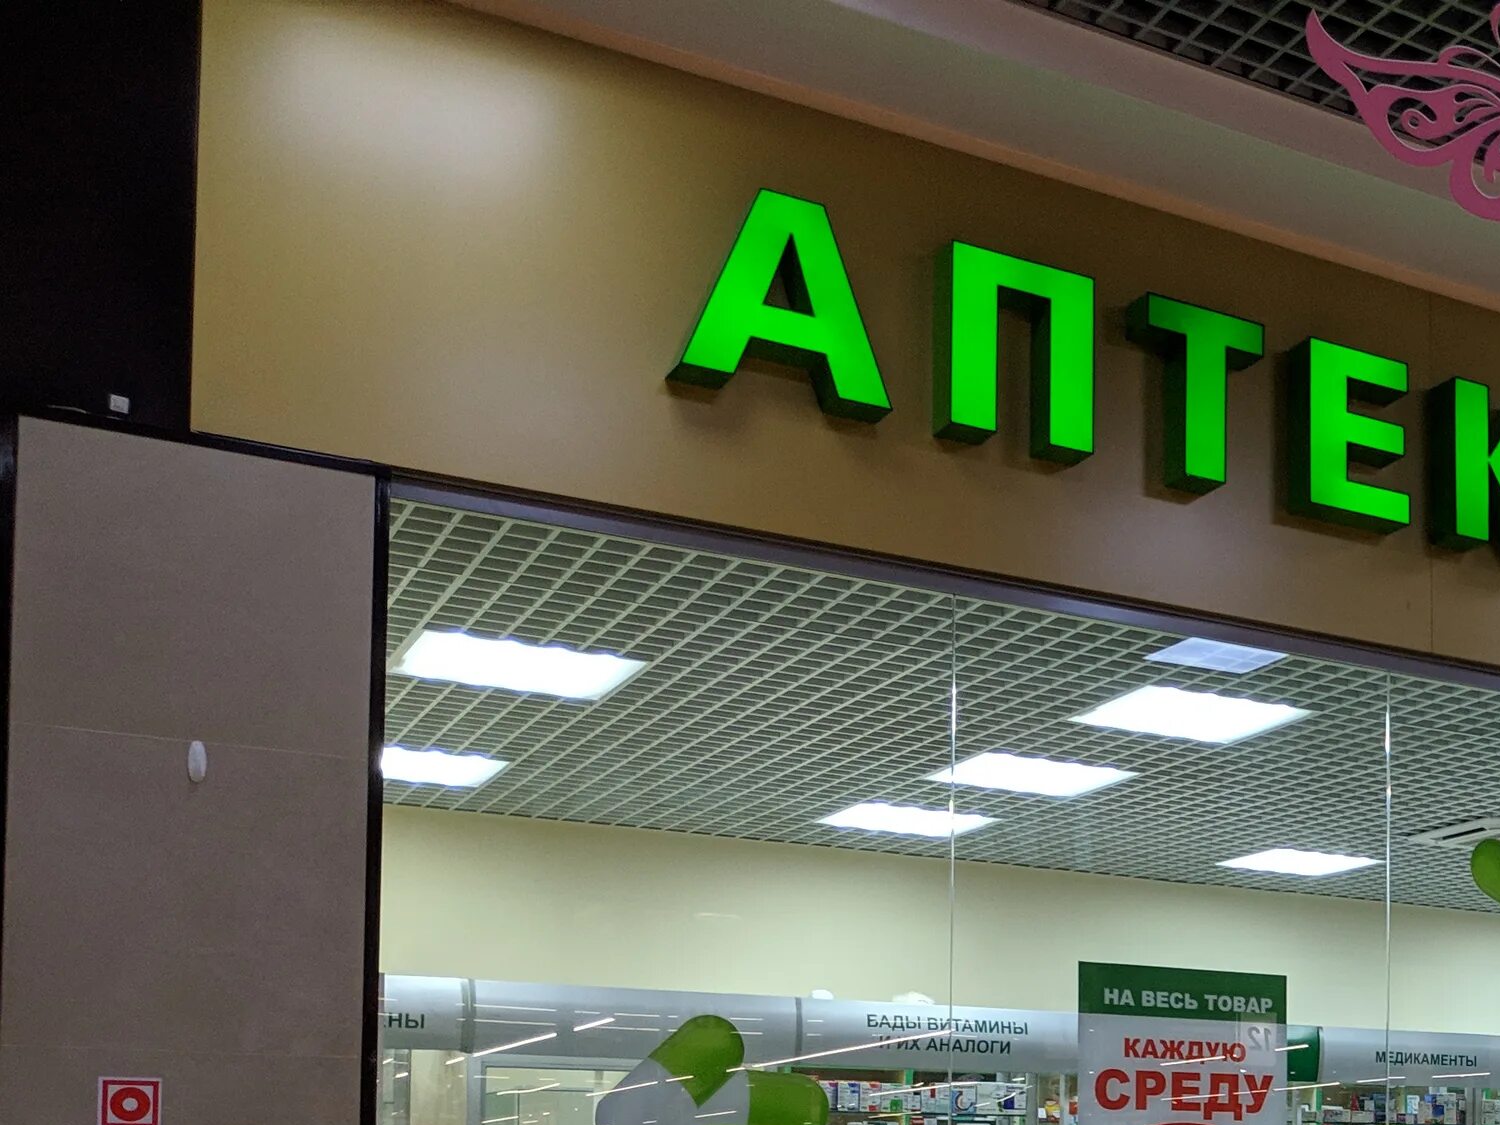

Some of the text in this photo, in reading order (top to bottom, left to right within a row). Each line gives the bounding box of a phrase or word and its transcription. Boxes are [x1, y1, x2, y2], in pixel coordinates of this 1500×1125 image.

[1103, 987, 1273, 1014] НА ВЕСЬ ТОВАР
[867, 1013, 1029, 1035] БАДЫ ВИТАМИНЫ
[897, 1036, 920, 1051] ИХ
[926, 1037, 1012, 1055] АНАЛОГИ
[1123, 1037, 1247, 1064] КАЖДУЮ
[1375, 1051, 1477, 1068] МЕДИКАМЕНТЫ
[1094, 1068, 1274, 1121] СРЕДУ
